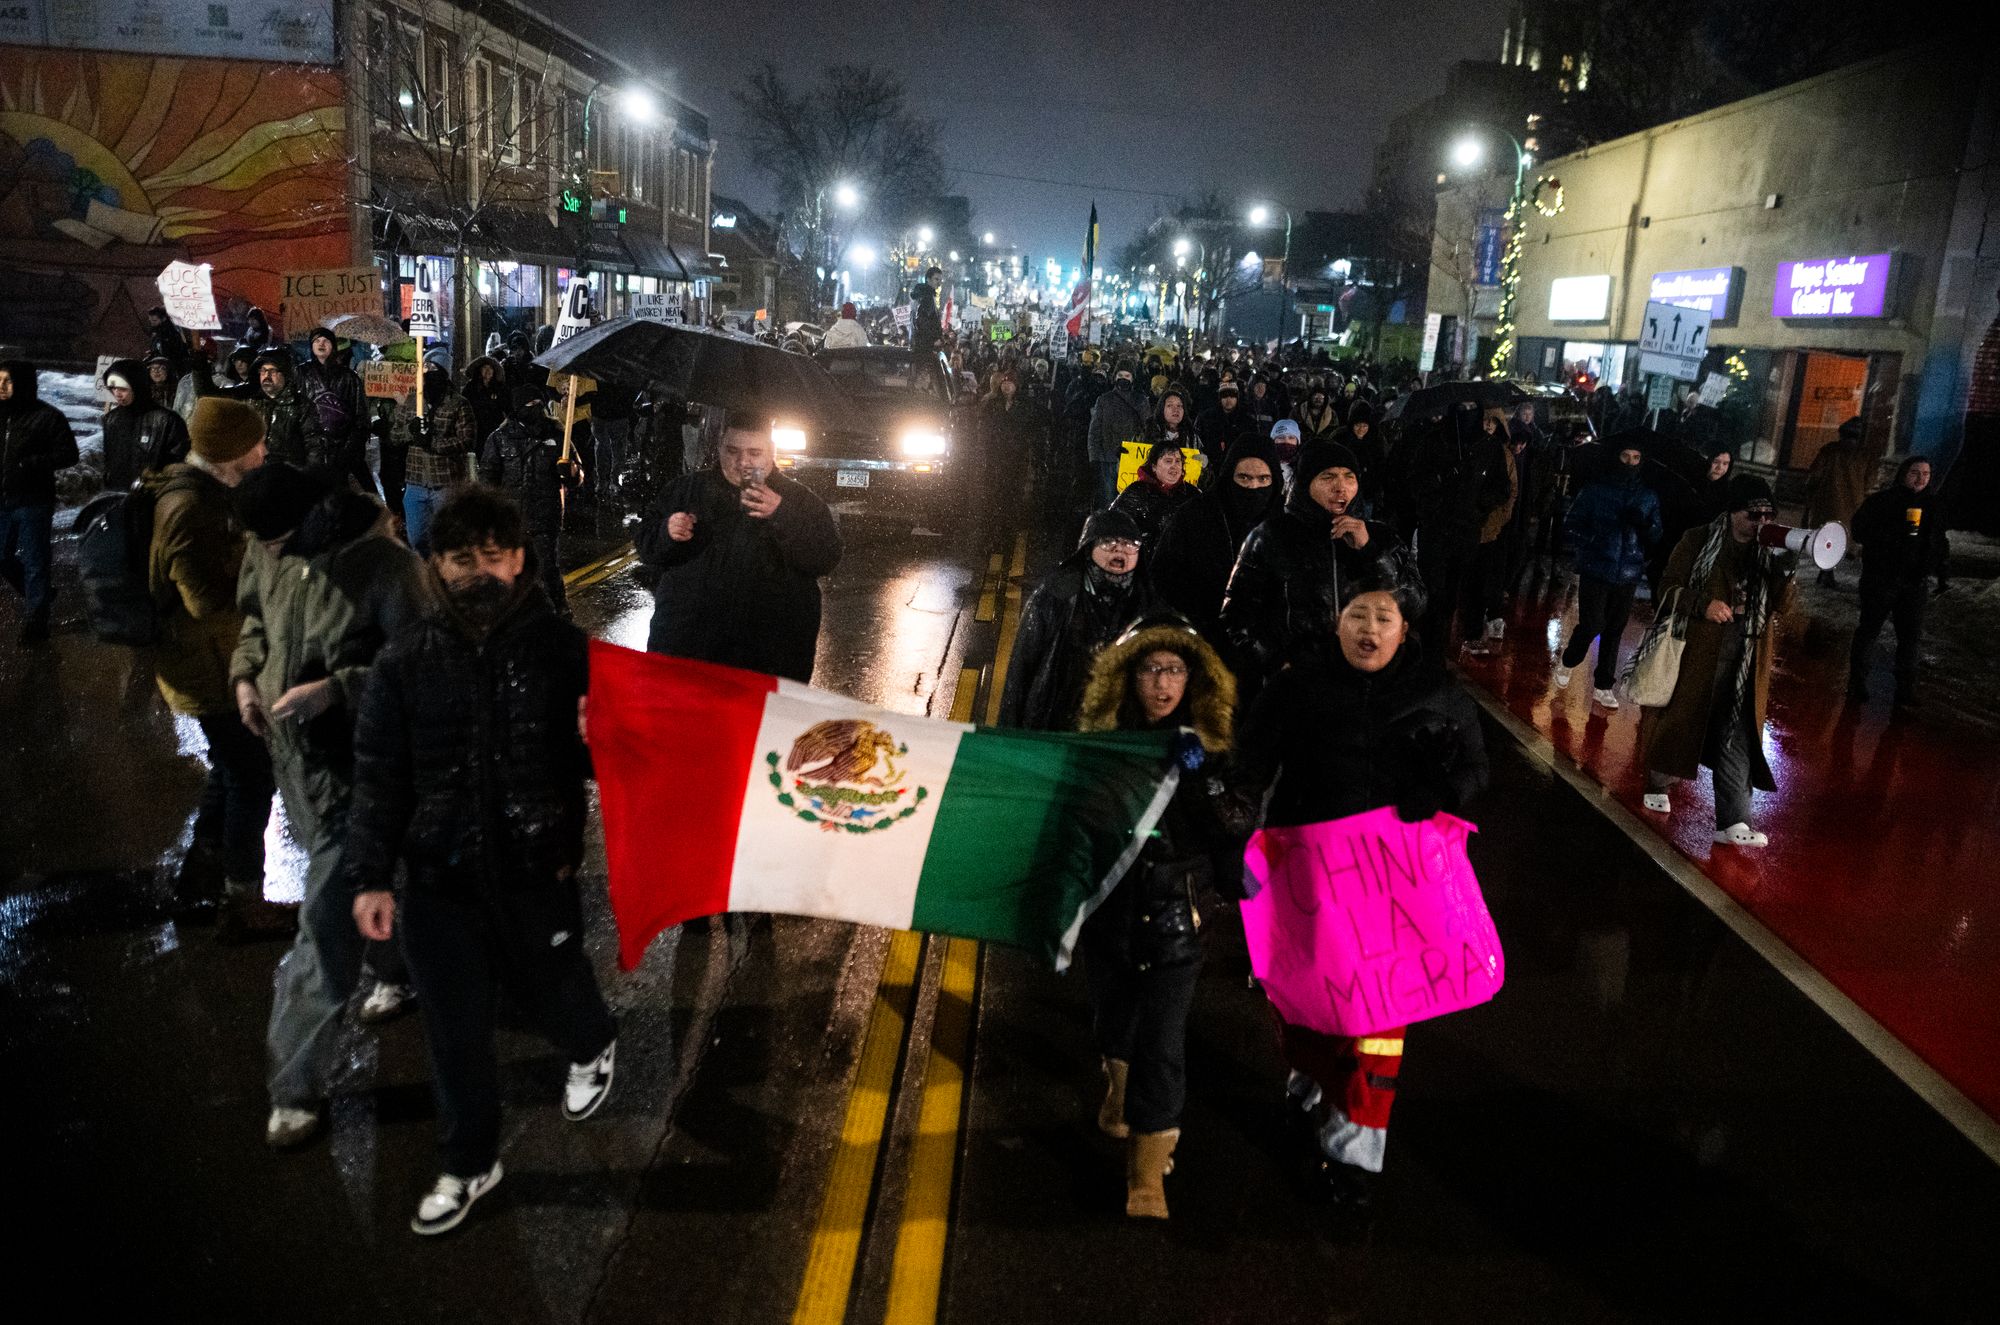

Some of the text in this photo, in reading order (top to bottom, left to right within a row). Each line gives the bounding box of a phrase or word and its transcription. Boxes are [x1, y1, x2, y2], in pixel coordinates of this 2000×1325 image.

[1484, 228, 1497, 283] MIDTOWN
[161, 267, 208, 287] FUCK
[1823, 255, 1869, 287] Senior
[168, 283, 203, 299] ICE
[283, 273, 377, 298] ICE JUST
[412, 298, 435, 313] TERR
[647, 294, 664, 306] LIKE
[668, 295, 680, 306] MY
[410, 313, 436, 324] OW
[633, 306, 681, 319] WHISKEY NEAT
[560, 325, 574, 338] OUT
[1643, 339, 1658, 348] ONLY
[1664, 342, 1680, 351] ONLY
[1686, 345, 1701, 354] ONLY
[391, 362, 417, 375] PEAC
[1346, 896, 1428, 961] LA
[1323, 942, 1493, 1032] MIGRA
